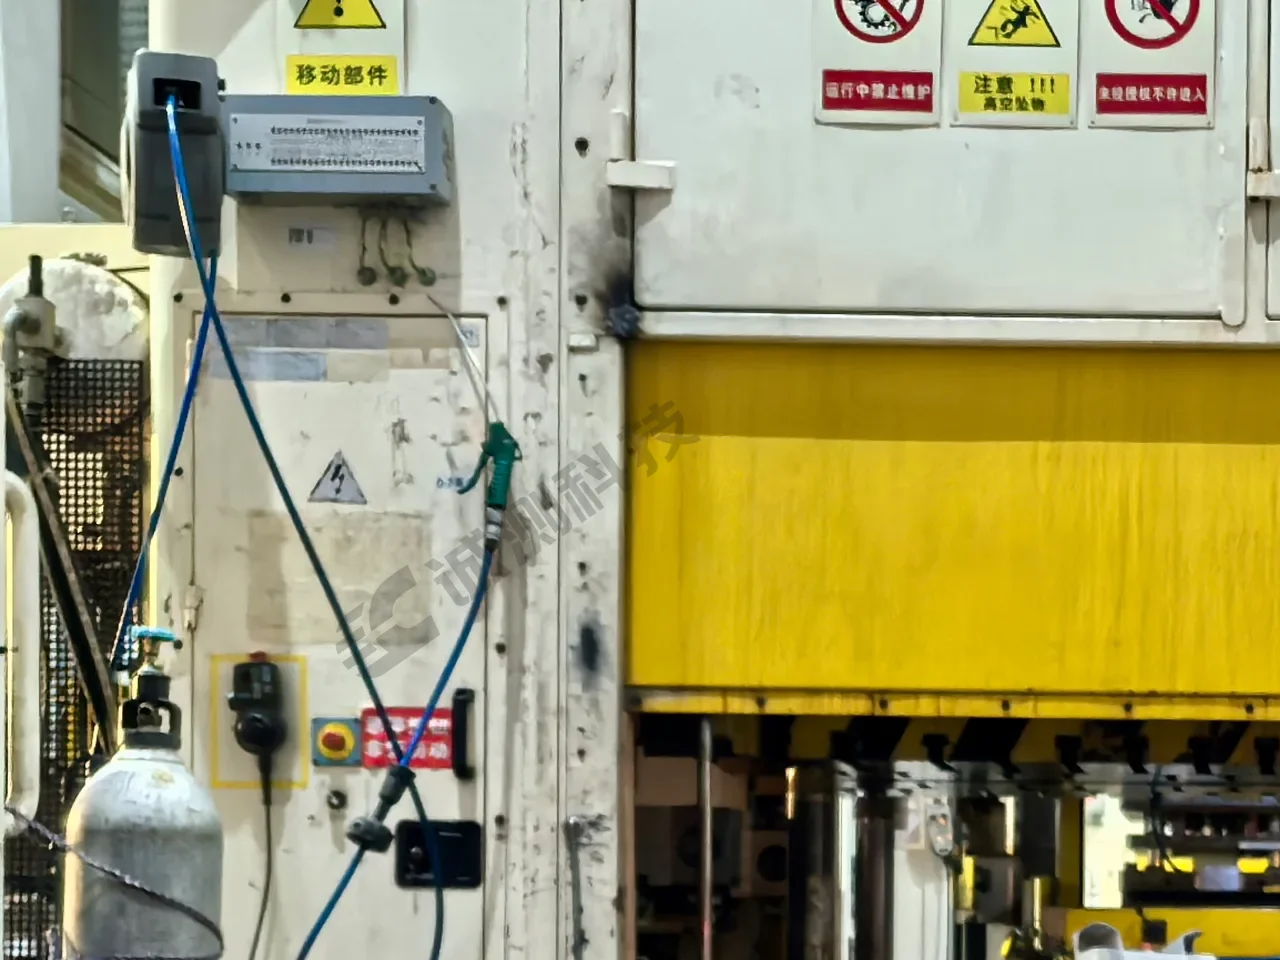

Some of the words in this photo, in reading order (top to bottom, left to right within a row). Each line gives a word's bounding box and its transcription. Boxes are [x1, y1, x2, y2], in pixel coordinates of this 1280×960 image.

[295, 64, 388, 86] 移动部件
[973, 74, 1013, 95] 注意
